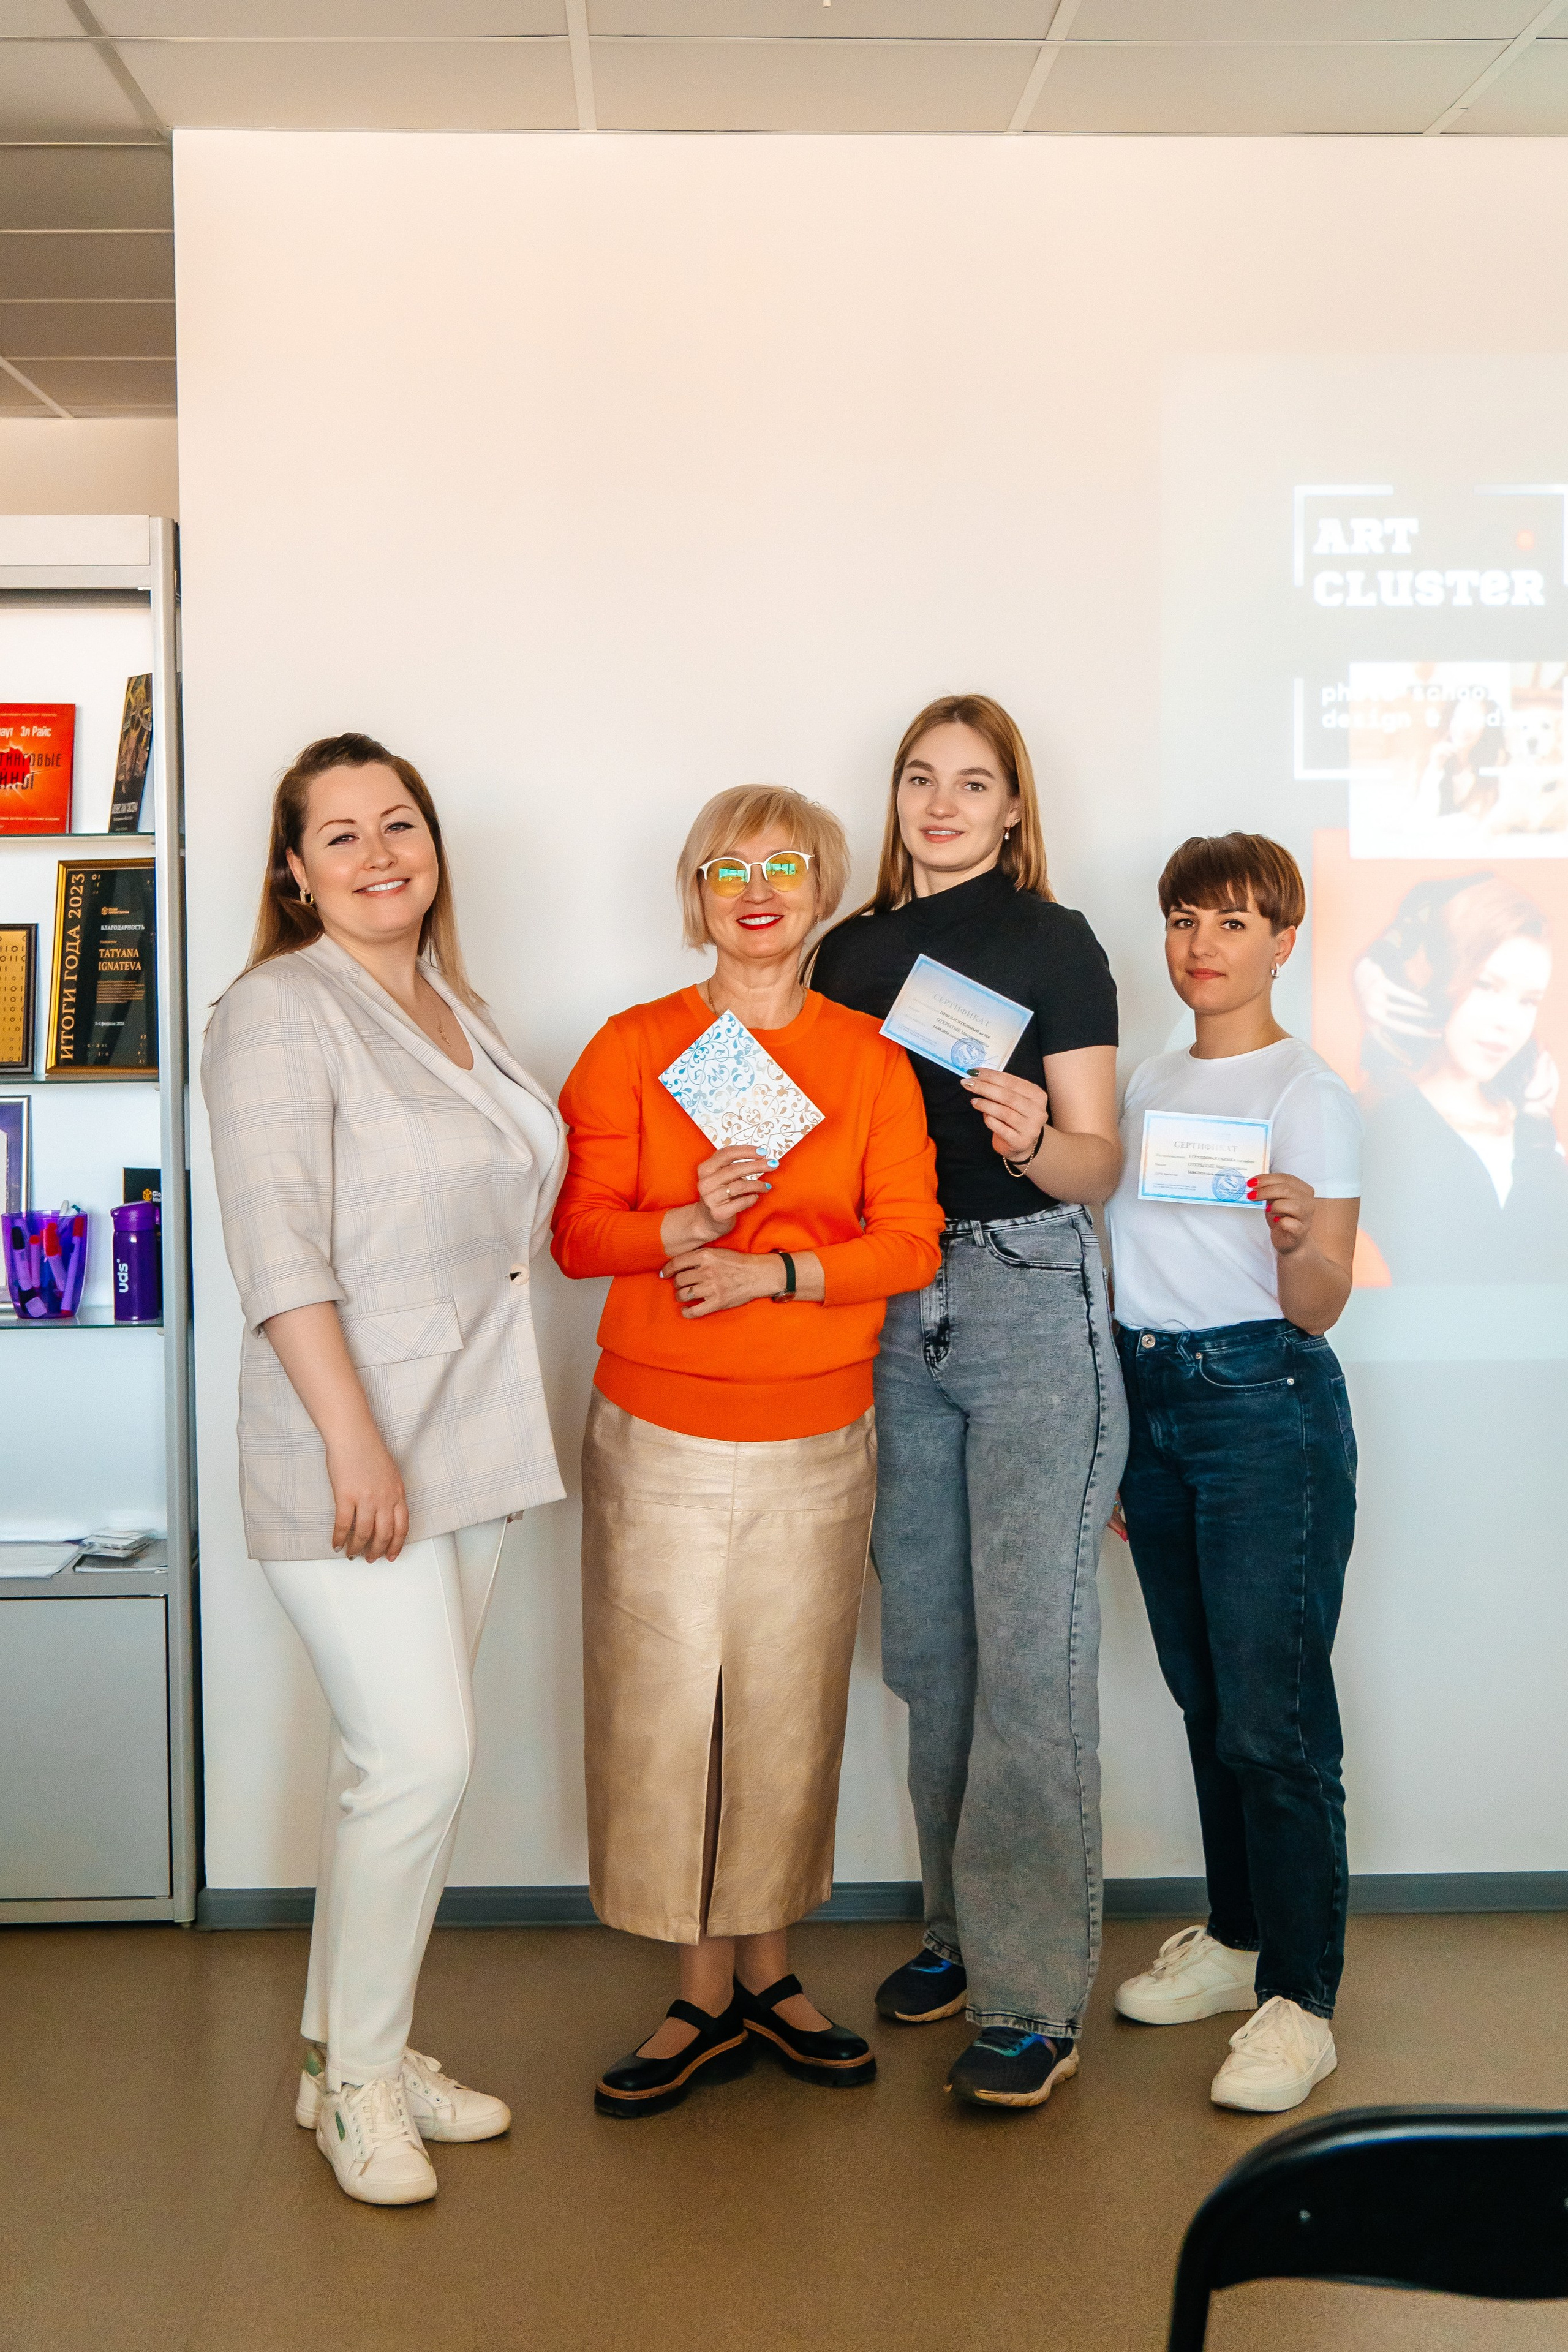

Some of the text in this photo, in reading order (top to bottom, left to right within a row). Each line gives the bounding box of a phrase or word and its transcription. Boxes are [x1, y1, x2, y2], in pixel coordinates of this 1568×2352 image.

[1313, 518, 1419, 554] ART
[99, 949, 139, 958] TATYANA
[60, 873, 85, 1060] ИТОГИ ГОДА 2023
[98, 961, 142, 971] IGNATEVA
[932, 992, 992, 1028] СЕРТИФИКАТ
[1174, 1140, 1238, 1153] СЕРТИФИКАТ
